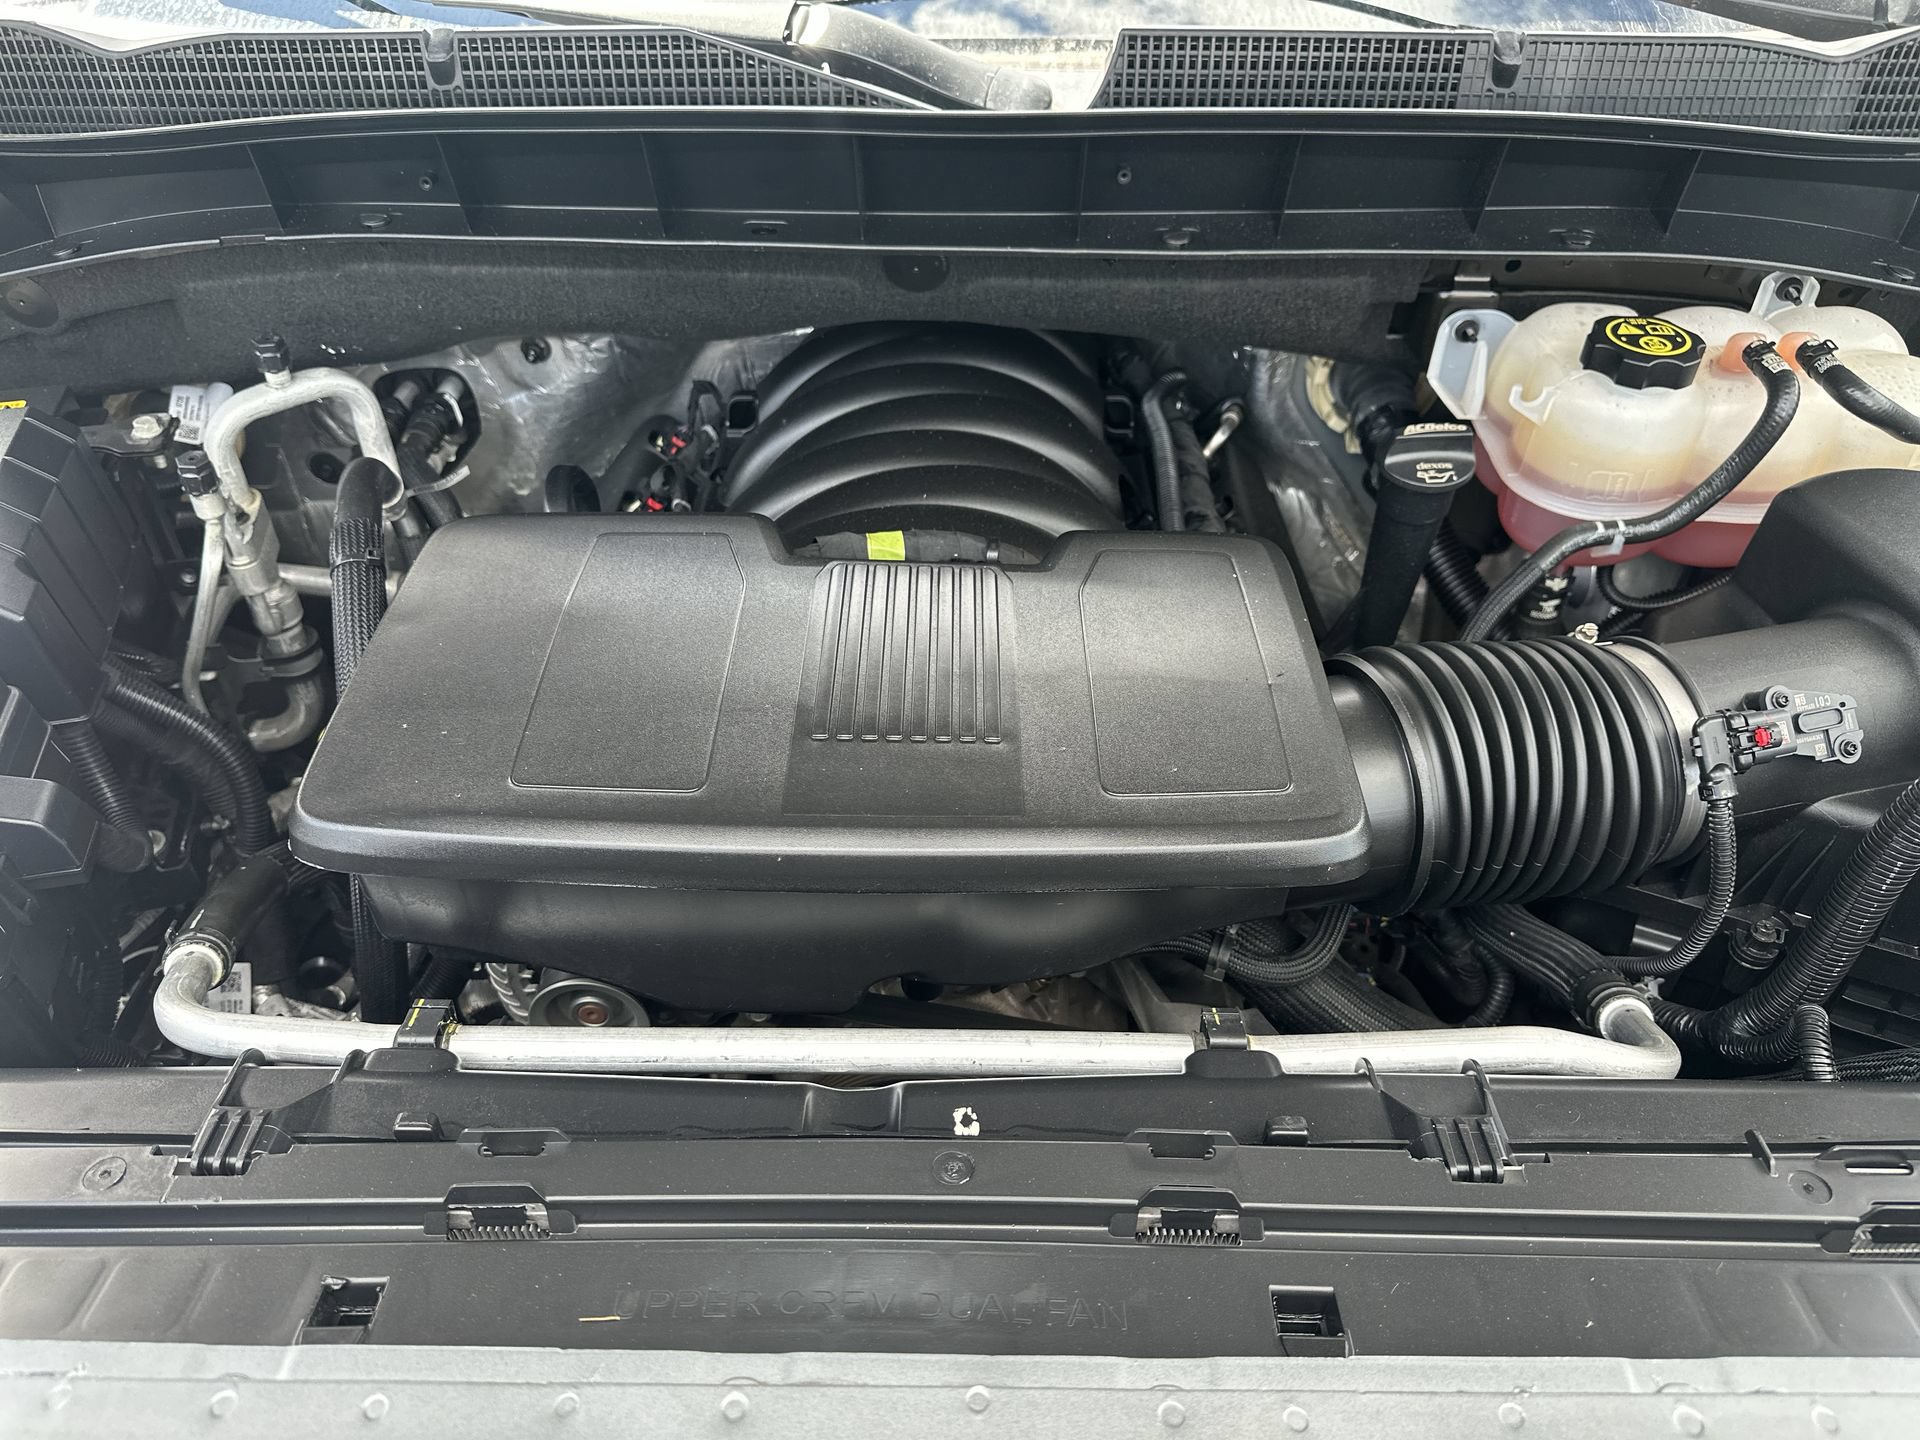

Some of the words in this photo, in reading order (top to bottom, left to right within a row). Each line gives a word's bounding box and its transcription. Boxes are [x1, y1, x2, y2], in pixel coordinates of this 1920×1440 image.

[1403, 422, 1468, 436] ACDelco
[1415, 462, 1453, 470] dexos
[1814, 695, 1830, 707] C01
[614, 1288, 763, 1320] UPPER
[918, 1290, 1033, 1325] DUAL
[1047, 1296, 1130, 1331] FAN
